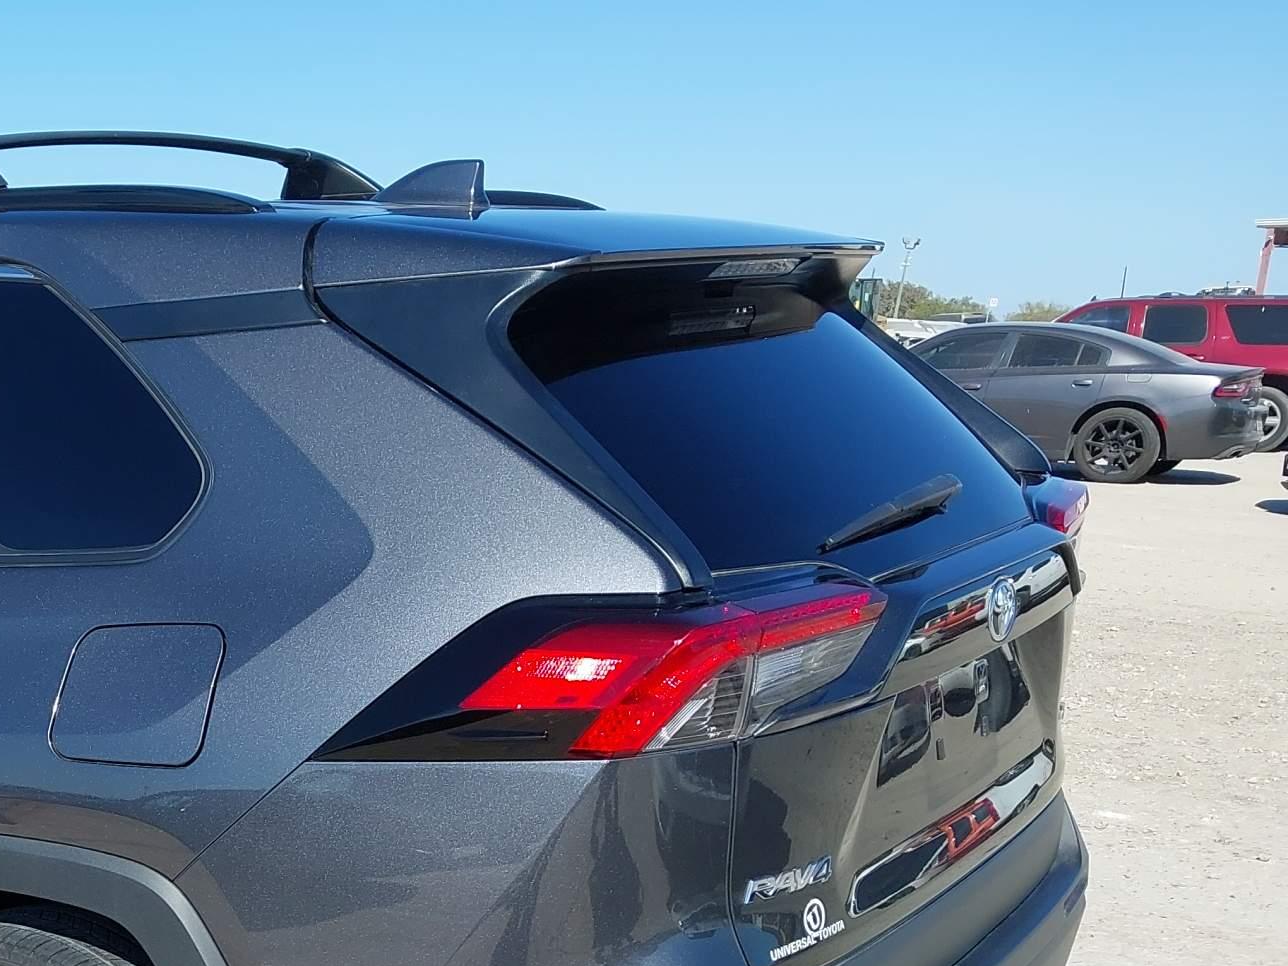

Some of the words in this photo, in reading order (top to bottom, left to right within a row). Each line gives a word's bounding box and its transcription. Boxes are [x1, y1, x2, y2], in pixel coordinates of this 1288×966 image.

[744, 856, 832, 904] RAV4
[769, 936, 817, 961] UNIVERSAL
[818, 919, 845, 941] TOYOTA
